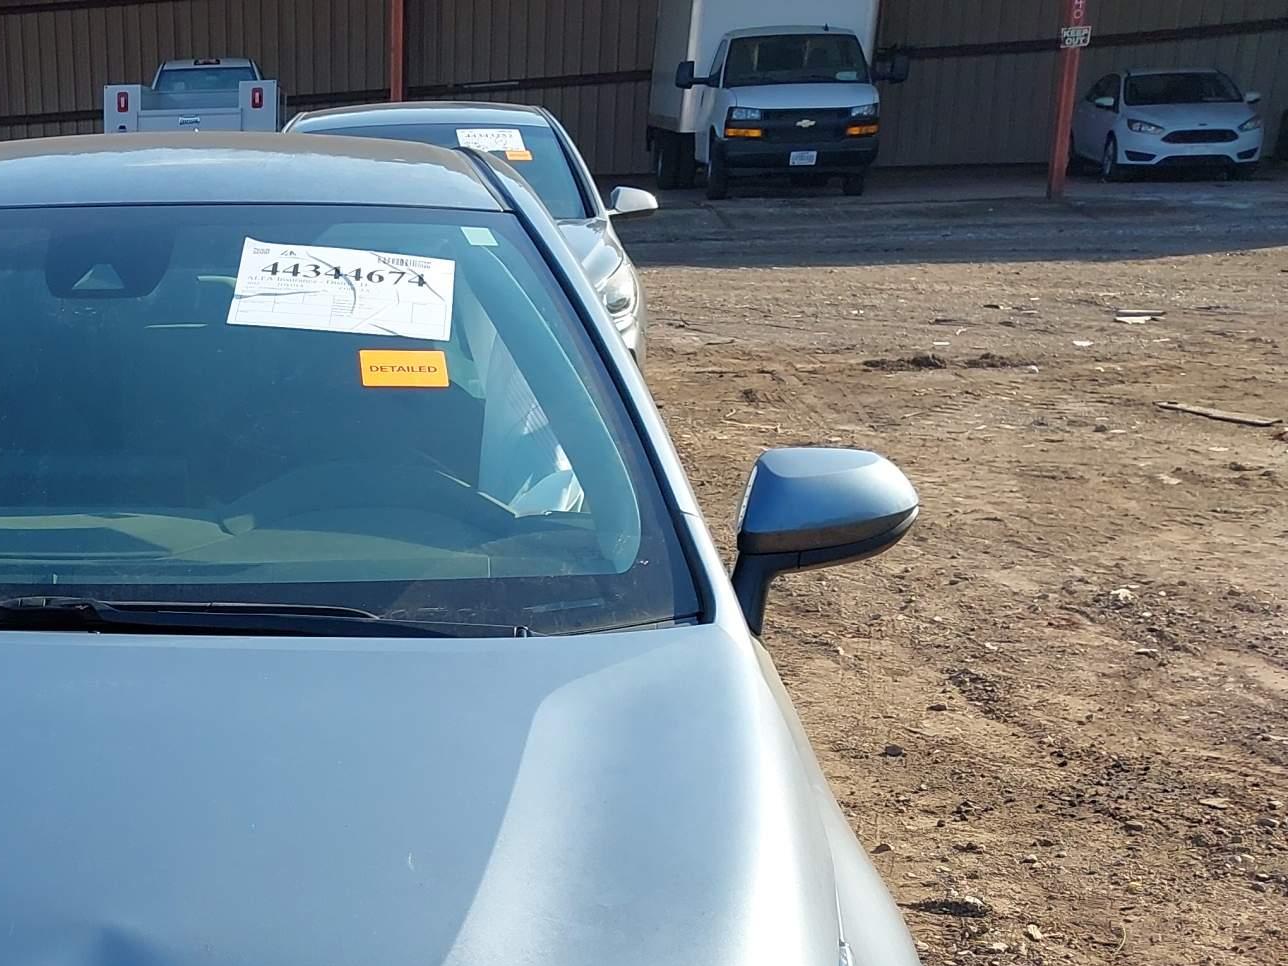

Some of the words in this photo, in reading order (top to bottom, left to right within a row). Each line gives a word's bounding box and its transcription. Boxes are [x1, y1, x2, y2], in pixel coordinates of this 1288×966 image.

[1064, 29, 1089, 37] KEEP
[1065, 37, 1087, 45] OUT
[261, 262, 426, 287] 44344674
[369, 365, 437, 373] DETAILED
